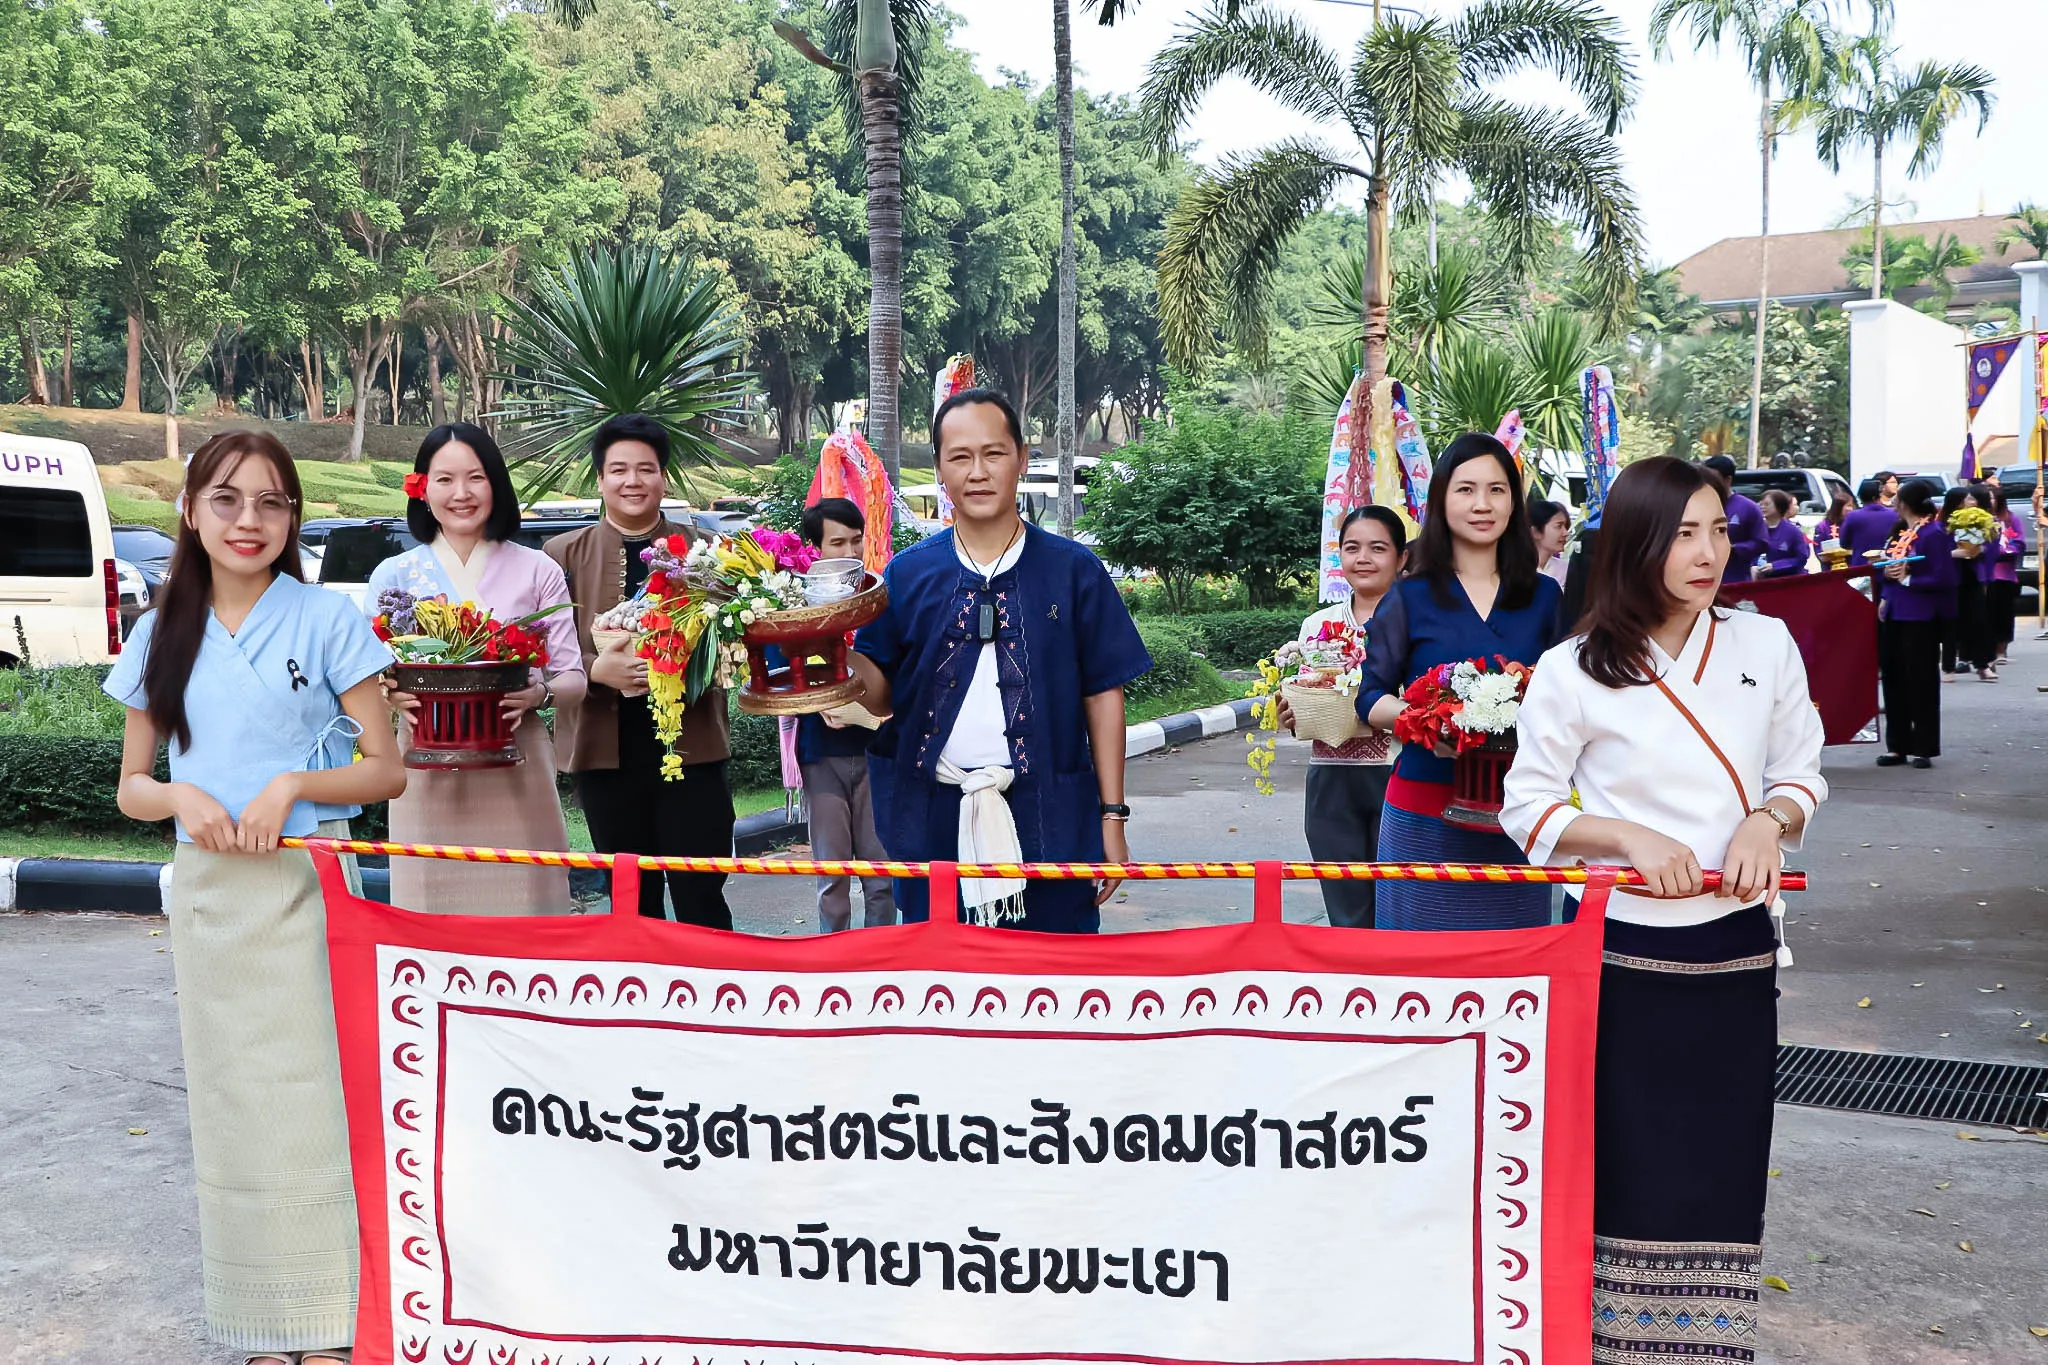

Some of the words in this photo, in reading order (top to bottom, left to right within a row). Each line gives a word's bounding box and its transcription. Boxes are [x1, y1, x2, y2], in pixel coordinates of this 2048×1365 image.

[2, 452, 64, 476] UPH
[492, 1086, 1434, 1171] คณะรัฐศาสตร์และสังคมศาสตร์
[667, 1222, 1229, 1302] มหาวิทยาลัยพะเยา
